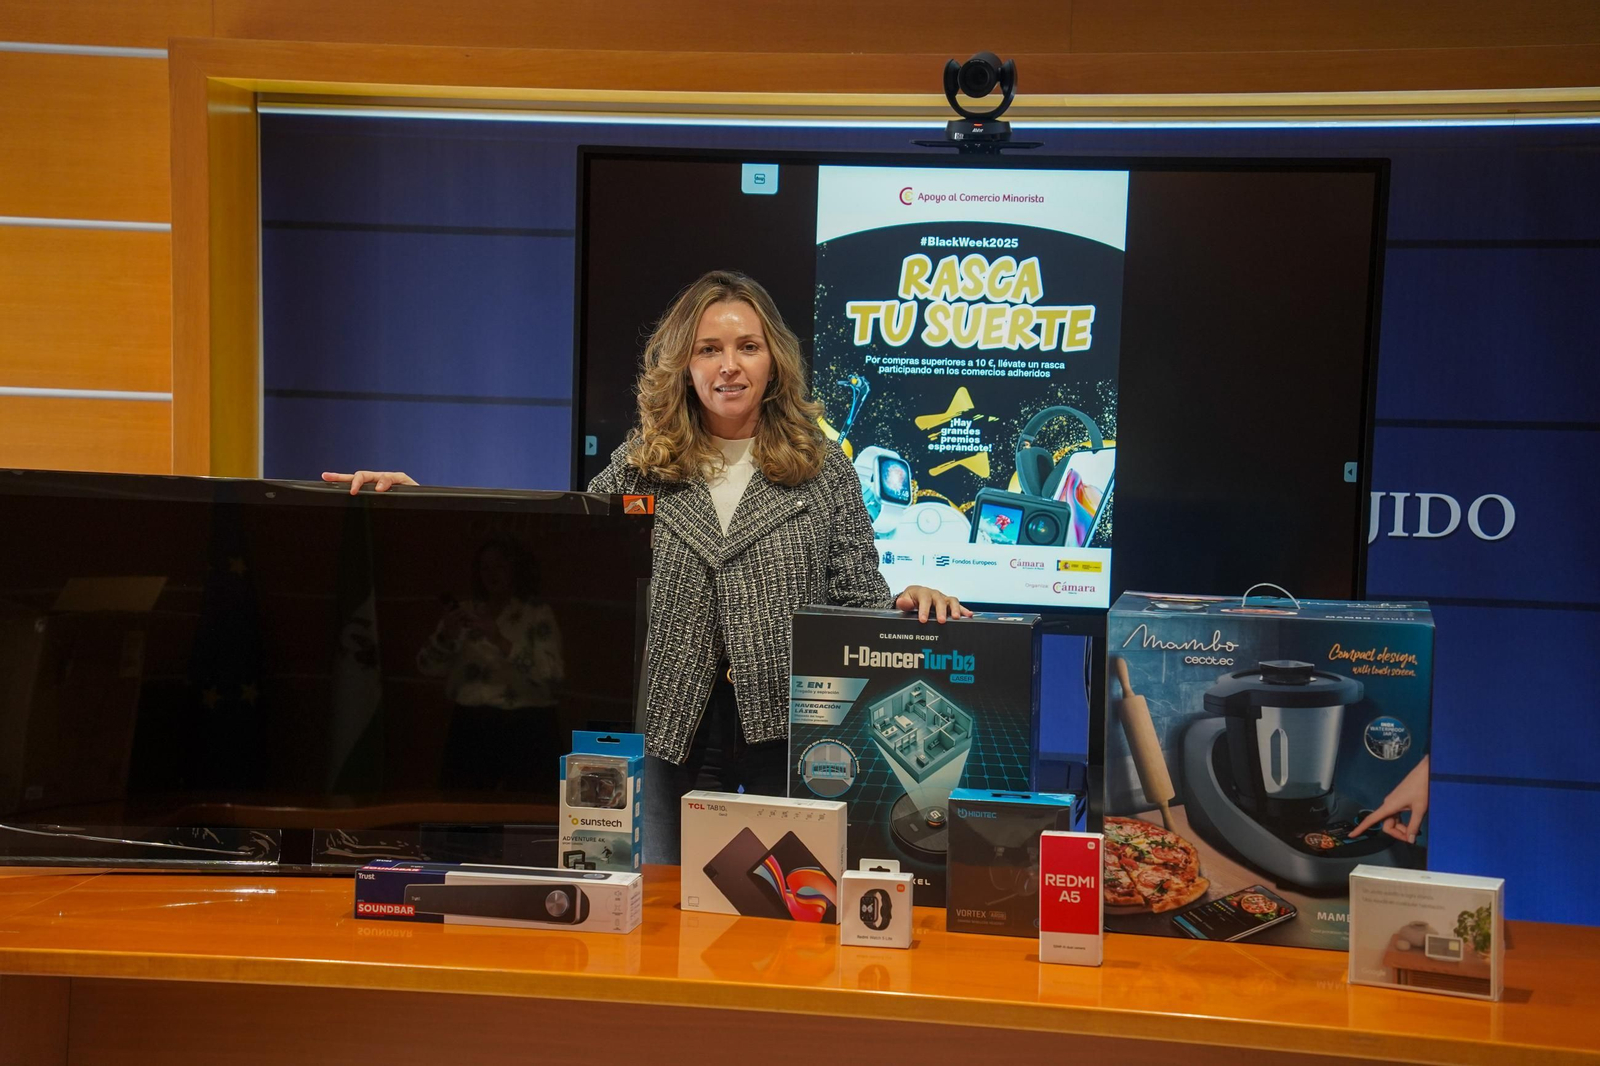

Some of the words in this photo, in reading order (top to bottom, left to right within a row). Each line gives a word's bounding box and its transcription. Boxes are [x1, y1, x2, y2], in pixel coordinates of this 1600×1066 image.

[918, 192, 948, 203] Apoyo
[949, 192, 957, 202] al
[959, 192, 1000, 203] Comercio
[1002, 193, 1044, 203] Minorista
[920, 236, 1019, 248] #BlackWeek2025
[899, 254, 1043, 303] RASCA
[847, 300, 918, 346] TU
[921, 302, 1095, 352] SUERTE
[865, 355, 880, 365] Por
[882, 357, 920, 368] compras
[921, 358, 966, 369] superiores
[975, 358, 986, 367] 10
[998, 358, 1026, 369] llévate
[1041, 362, 1065, 370] rasca
[879, 365, 932, 376] participando
[934, 367, 945, 375] en
[947, 366, 959, 375] los
[961, 367, 1006, 377] comercios
[1008, 367, 1051, 378] adheridos
[950, 418, 972, 429] ¡Hay
[941, 426, 981, 436] grandes
[940, 435, 980, 445] premios
[928, 442, 992, 452] esperándote!
[1368, 491, 1516, 545] JIDO
[972, 559, 997, 567] Europeos
[1010, 558, 1045, 569] Cámara
[1052, 581, 1096, 594] Cámara
[879, 633, 914, 641] CLEANING
[916, 634, 939, 642] ROBOT
[1123, 624, 1239, 652] Mambo
[1329, 643, 1376, 662] Compact
[1185, 655, 1234, 666] cecotec
[1352, 665, 1370, 675] with
[1371, 666, 1390, 676] touch
[581, 818, 622, 828] sunstech
[1045, 873, 1095, 889] REDMI
[1059, 890, 1081, 903] A5
[358, 904, 413, 914] SOUNDBAR
[956, 909, 986, 918] VORTEX
